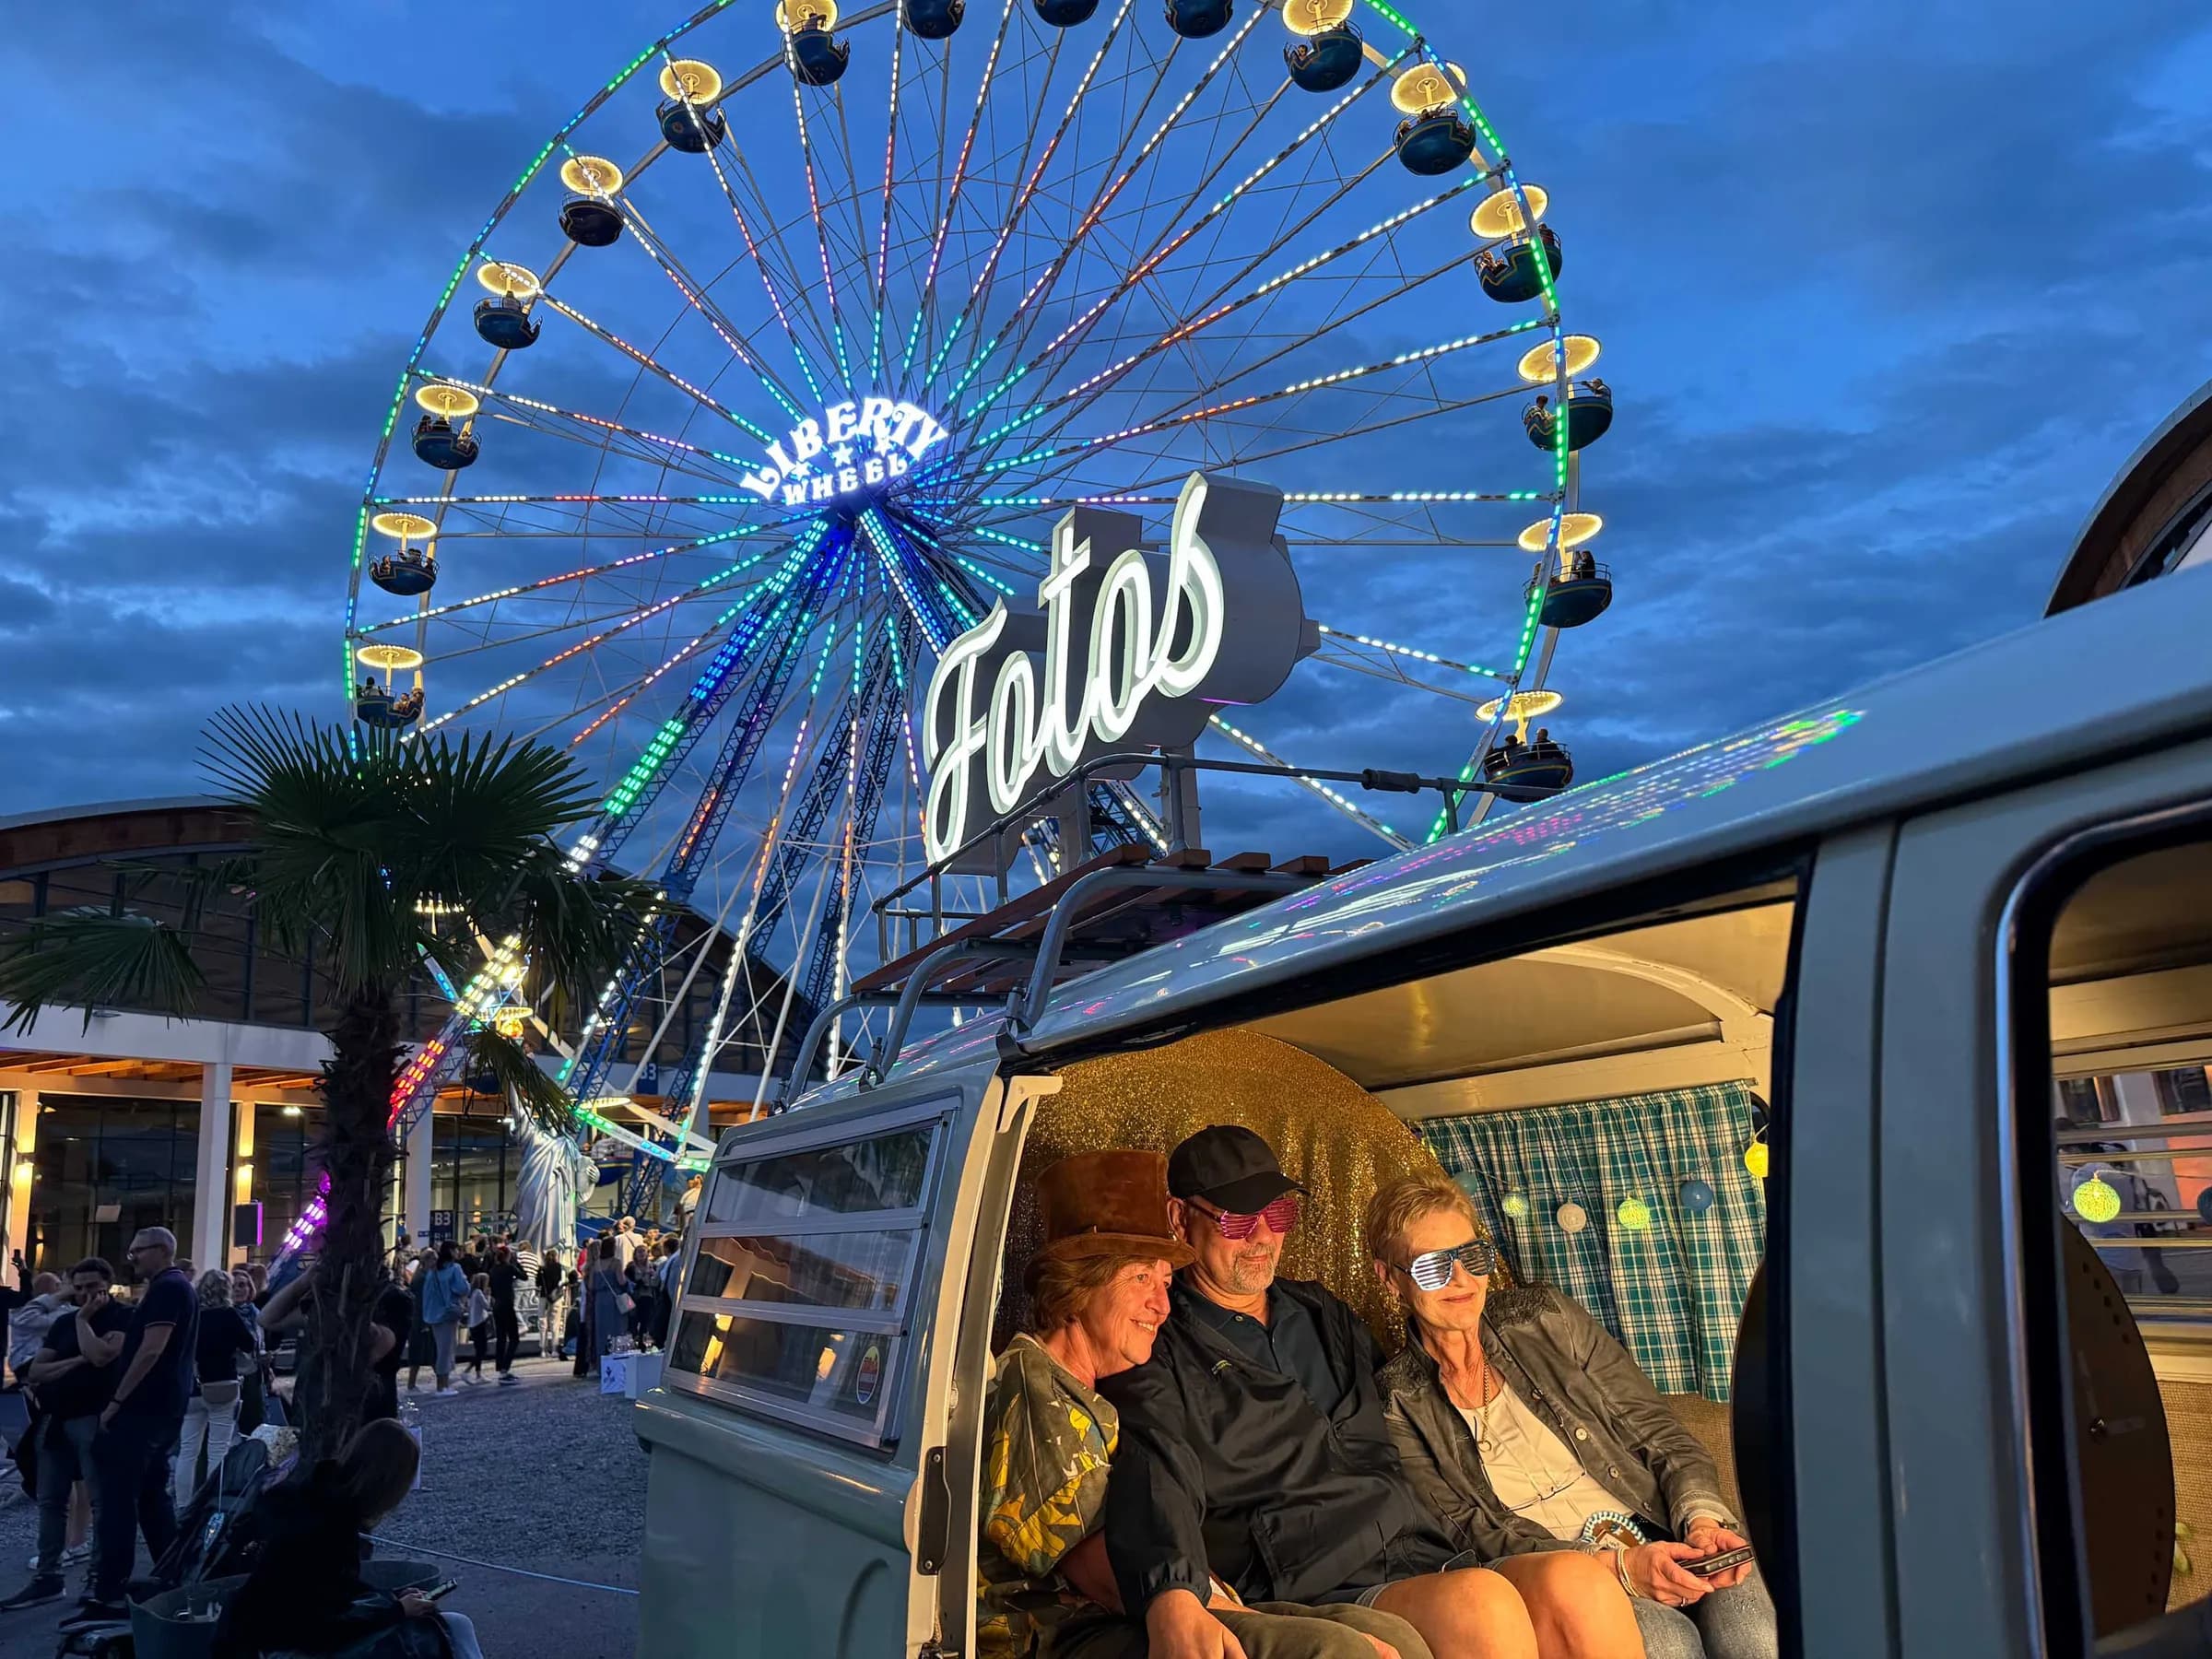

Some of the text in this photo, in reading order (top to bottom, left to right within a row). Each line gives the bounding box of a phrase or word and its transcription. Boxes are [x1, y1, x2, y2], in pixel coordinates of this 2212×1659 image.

[739, 397, 948, 500] LIBERTY
[782, 453, 908, 506] WHEEL
[923, 471, 1224, 874] Fotos
[434, 1212, 451, 1226] B3
